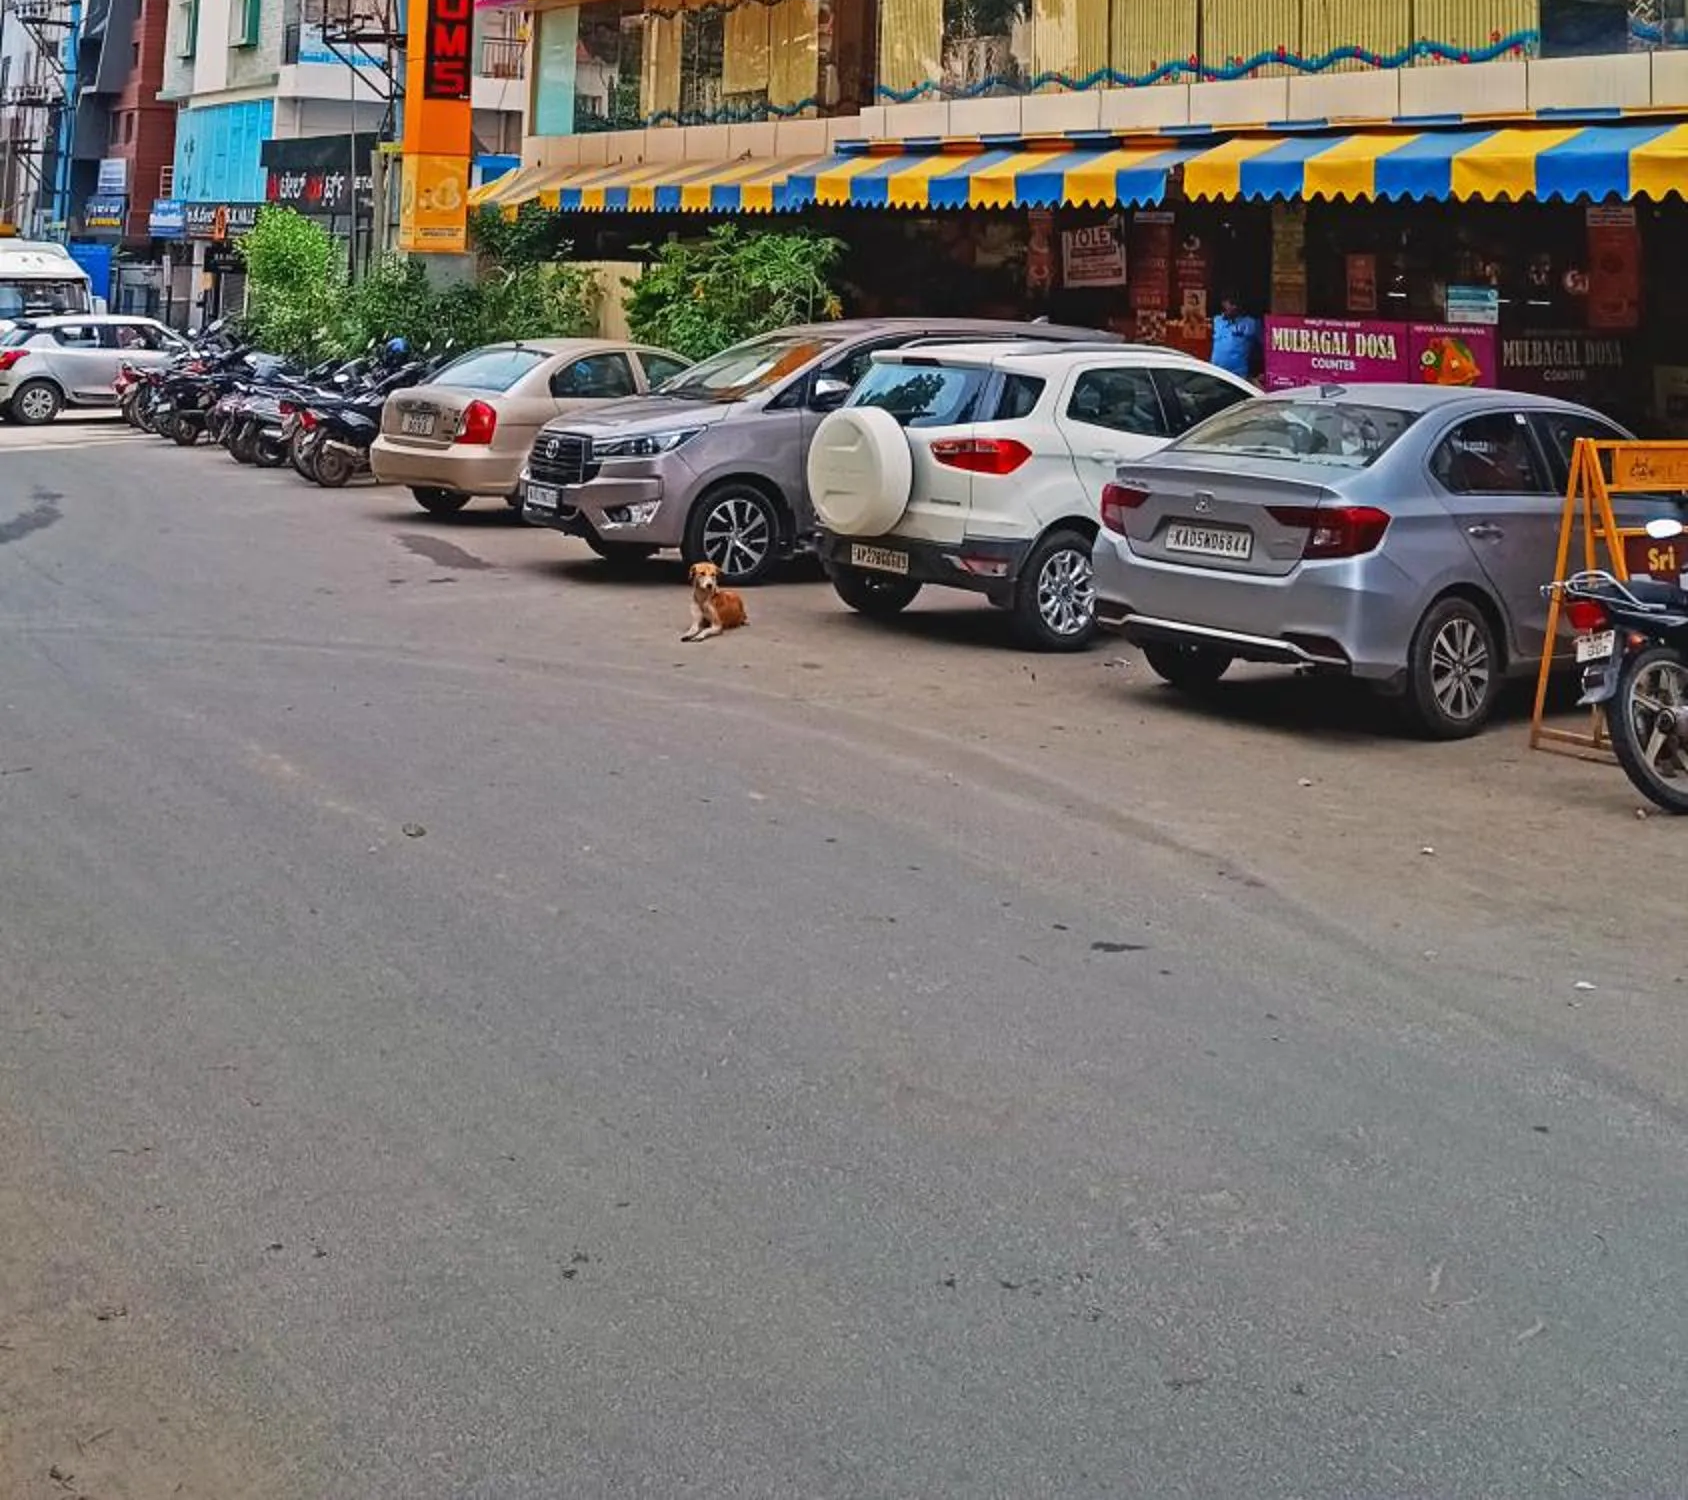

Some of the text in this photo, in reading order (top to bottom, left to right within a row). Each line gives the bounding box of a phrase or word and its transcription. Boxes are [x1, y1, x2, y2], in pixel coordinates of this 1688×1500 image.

[1271, 327, 1397, 361] MULBAGAL DOSA
[1503, 339, 1623, 369] MULBAGAL DOSA
[1311, 357, 1357, 372] COUNTER
[1647, 545, 1676, 572] Sri
